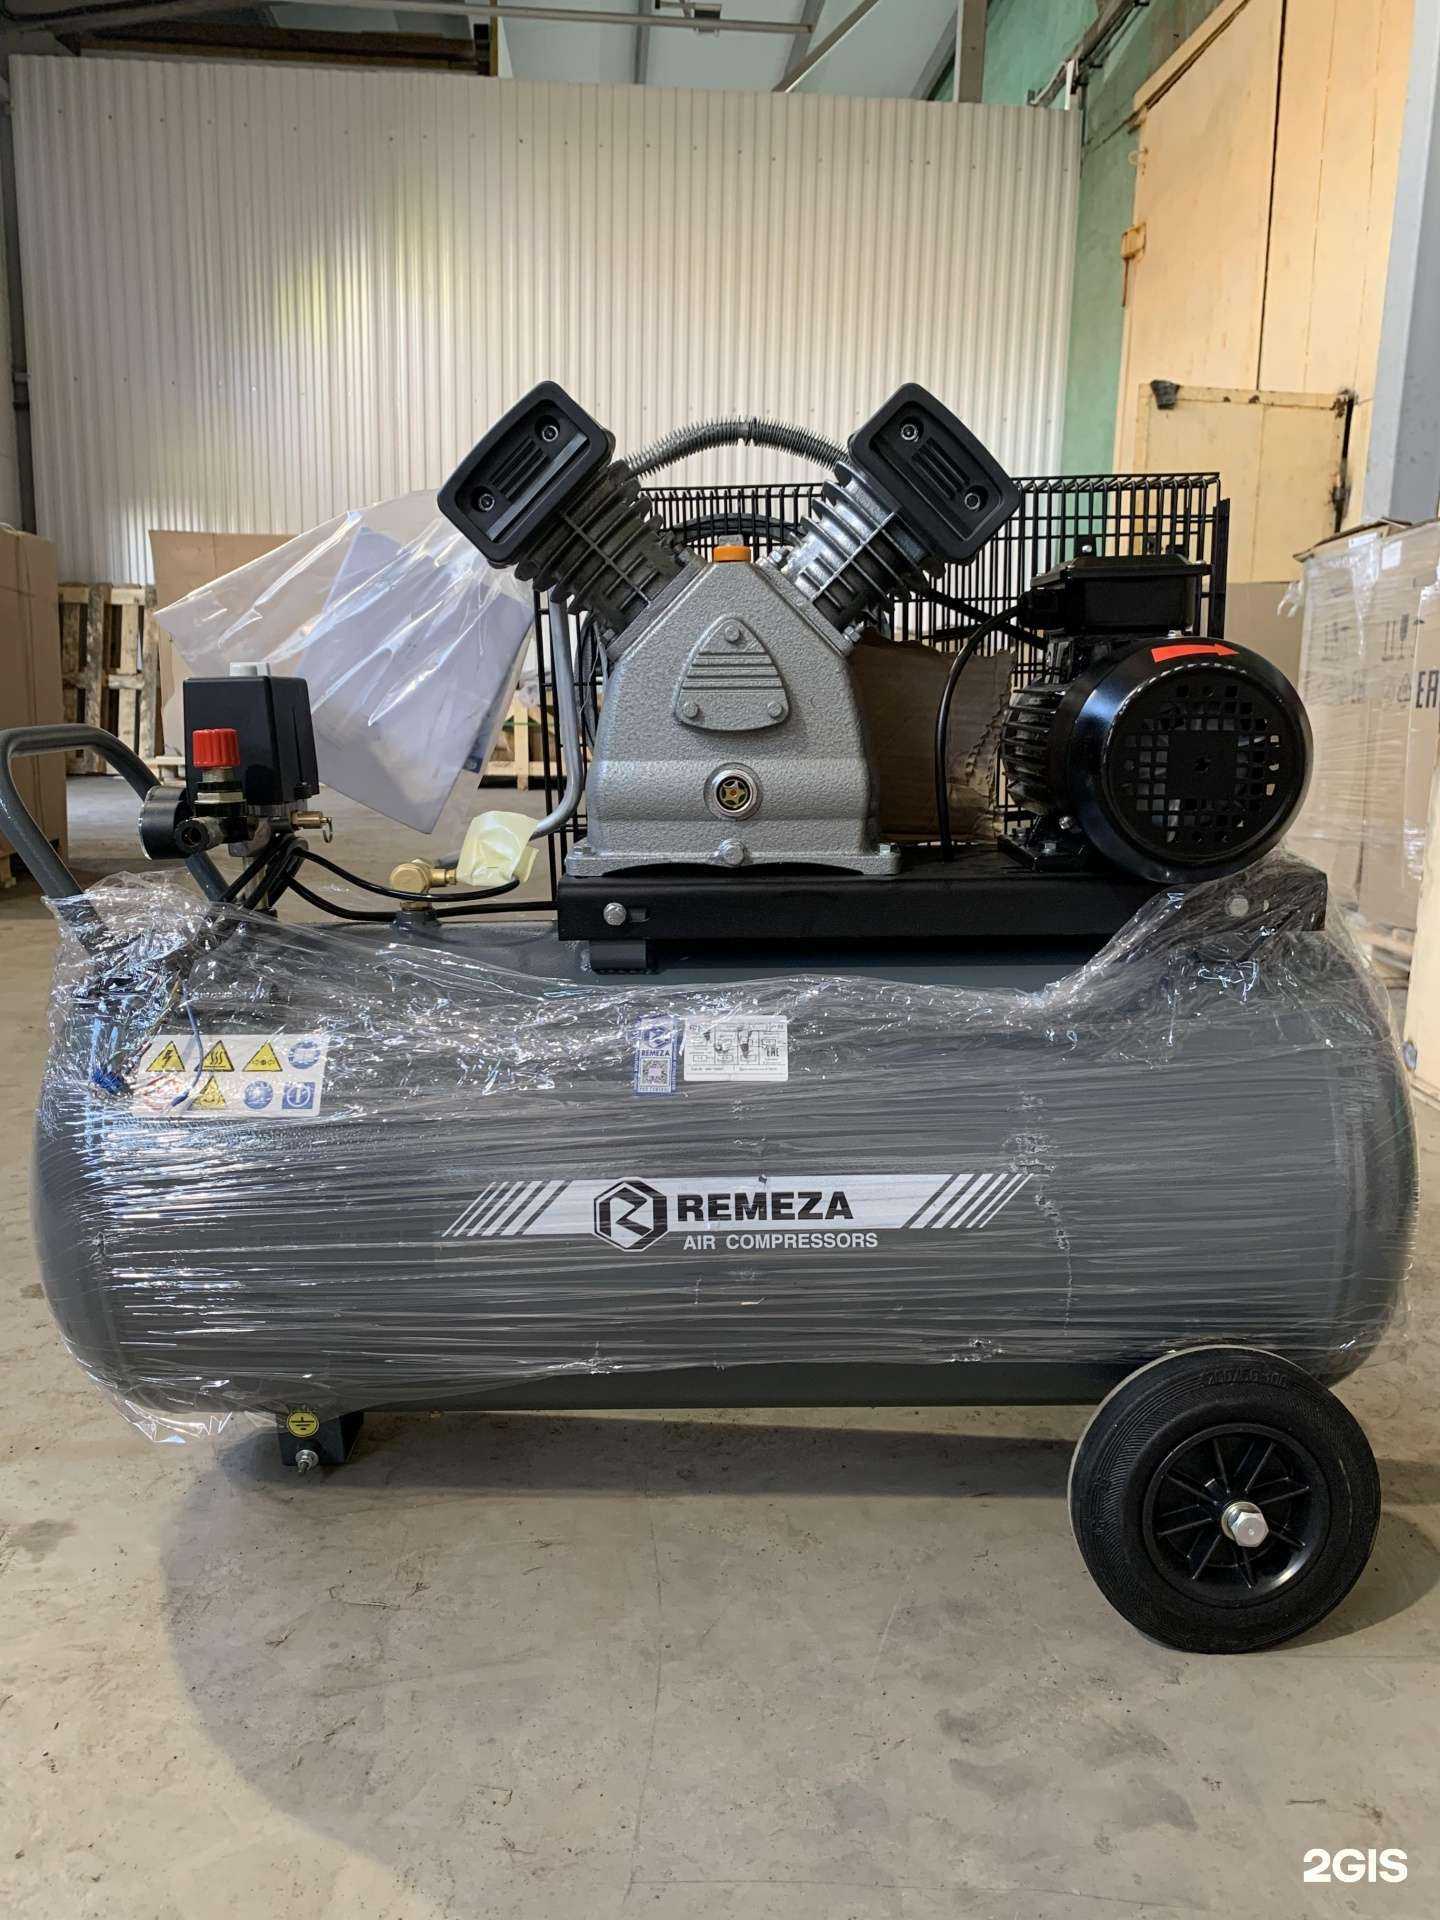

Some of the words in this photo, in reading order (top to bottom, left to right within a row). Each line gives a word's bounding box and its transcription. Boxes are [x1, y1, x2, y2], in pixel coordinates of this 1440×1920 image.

[677, 1191, 854, 1222] REMEZA
[684, 1235, 716, 1250] AIR
[726, 1232, 878, 1249] COMPRESSORS
